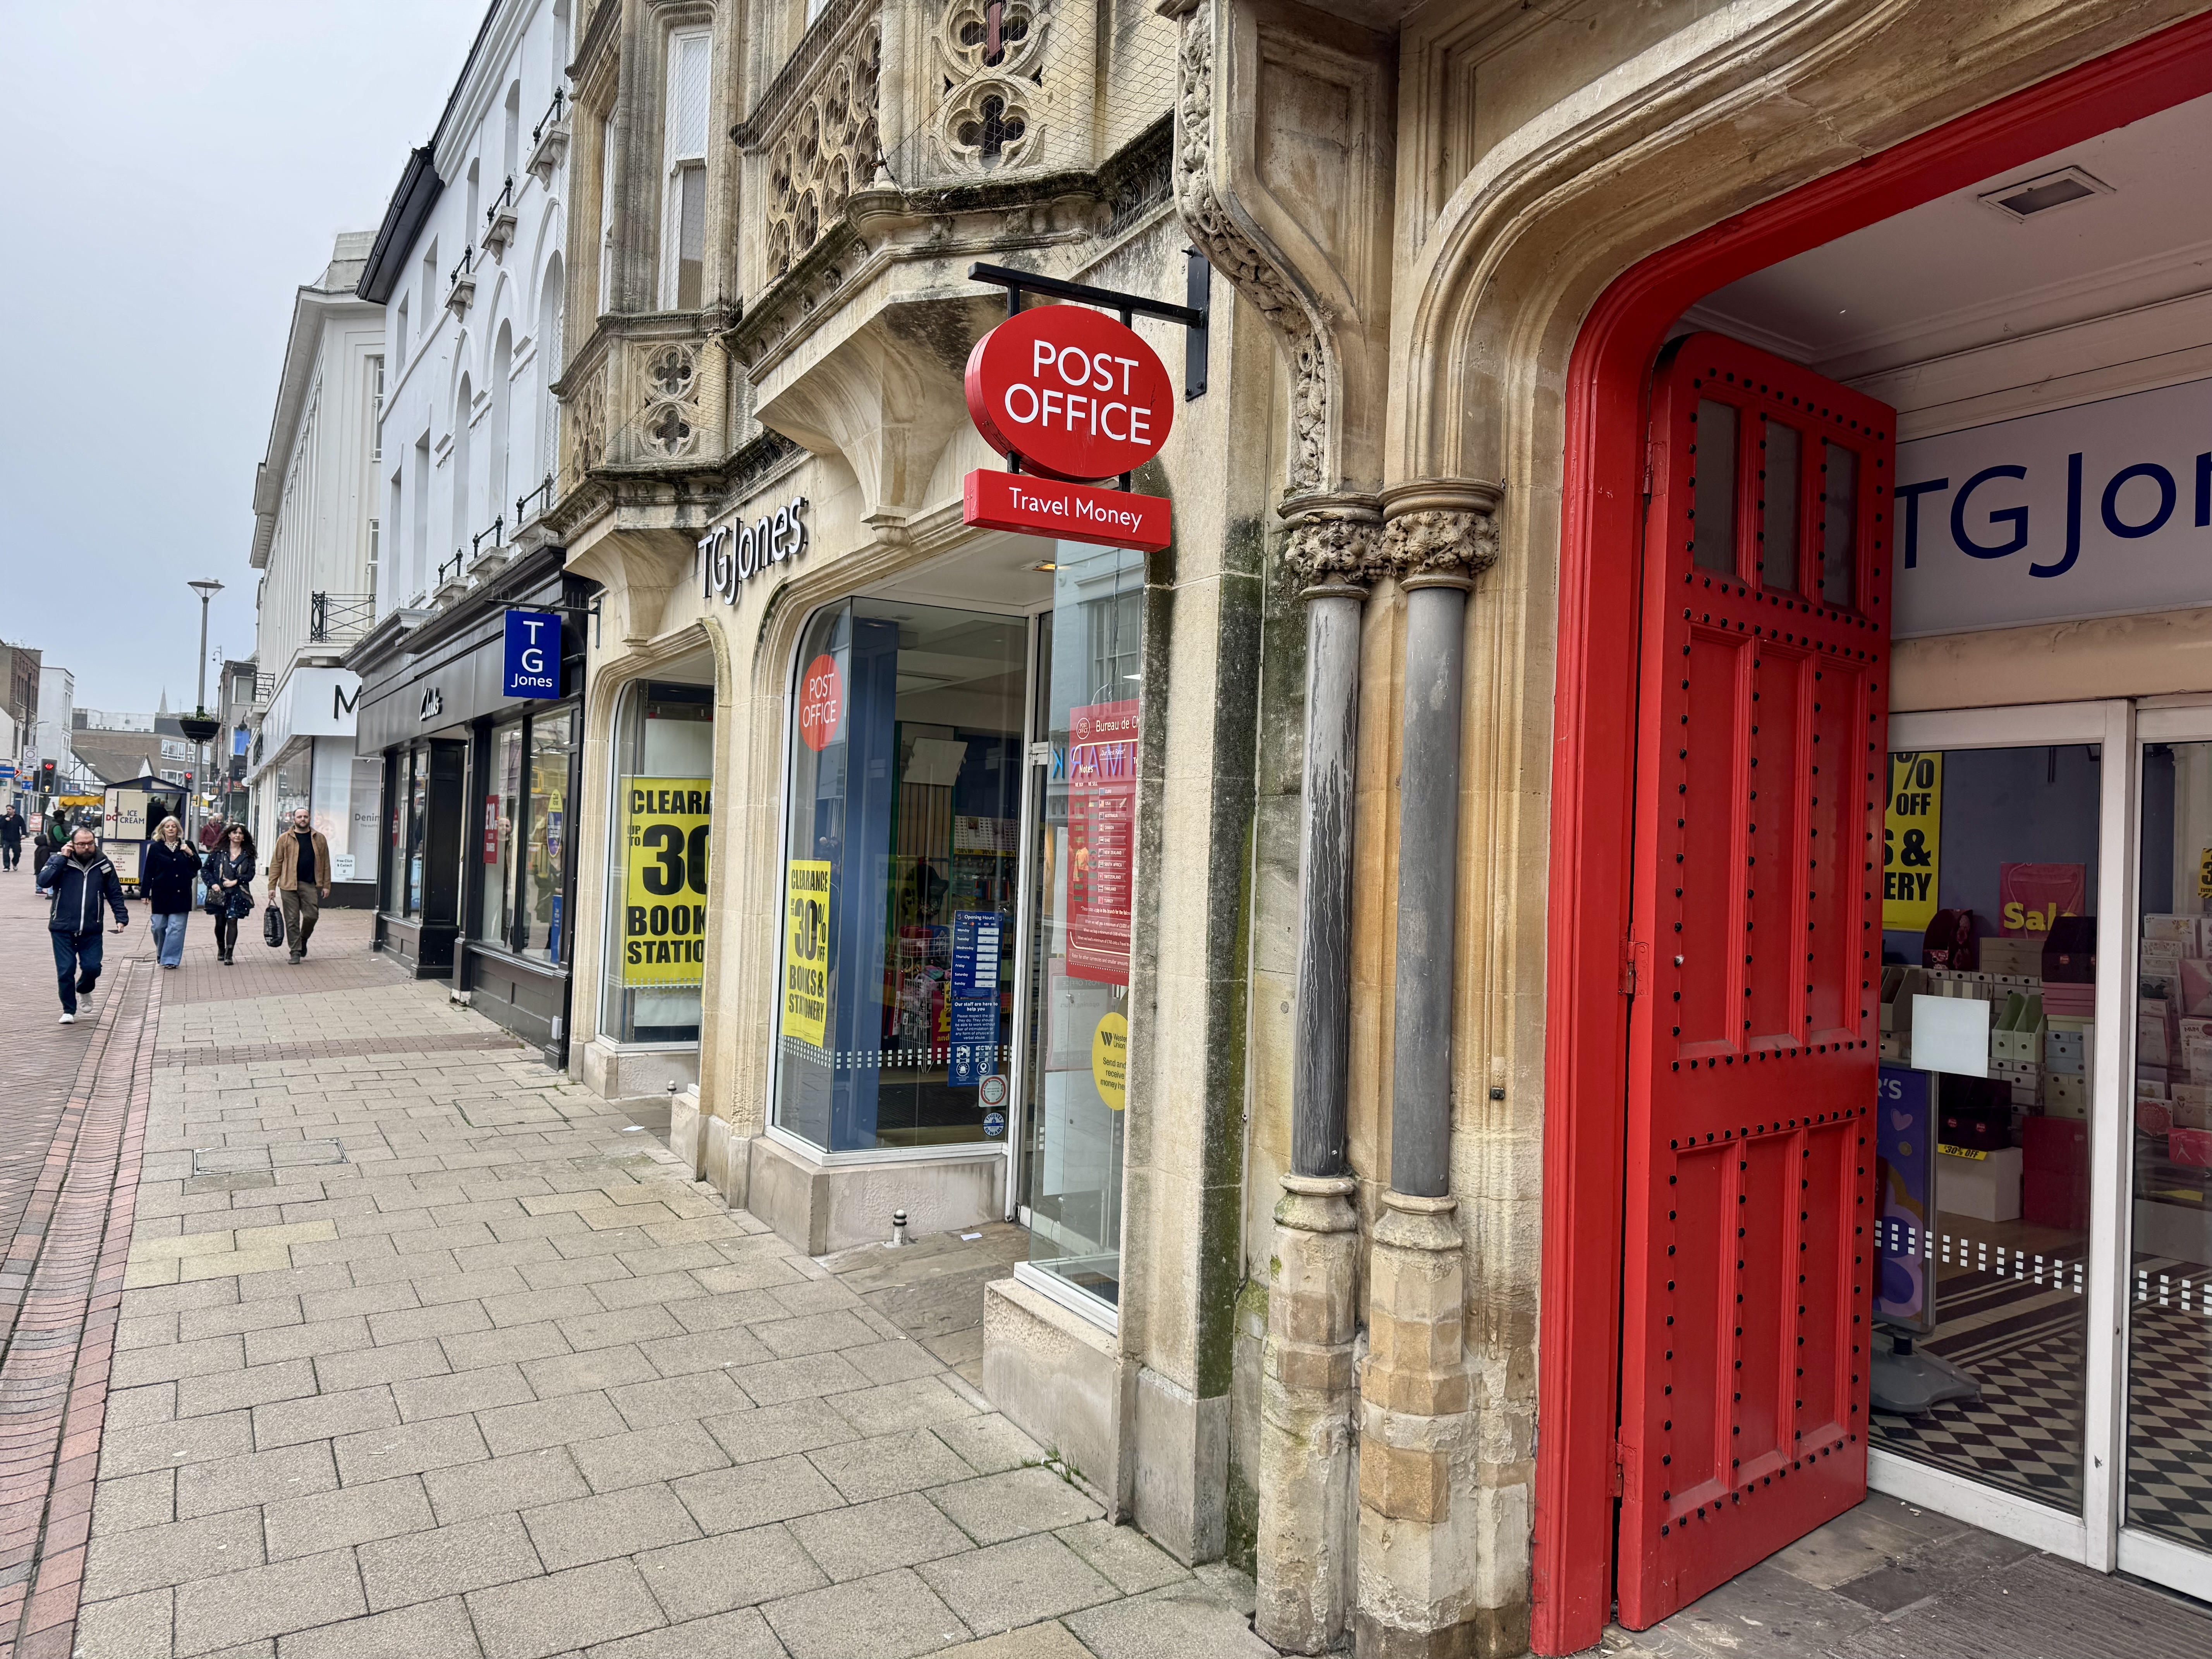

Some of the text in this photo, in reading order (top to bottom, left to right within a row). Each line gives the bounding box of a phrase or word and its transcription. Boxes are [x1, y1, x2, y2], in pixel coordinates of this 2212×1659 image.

[1034, 340, 1139, 395] POST
[1005, 383, 1151, 445] OFFICE
[1009, 487, 1142, 533] Travel Money
[523, 621, 544, 644] T
[522, 648, 543, 673] G
[511, 673, 552, 688] Jones
[810, 673, 834, 700] POST
[419, 687, 439, 721] Clarks
[803, 700, 836, 728] OFFICE
[1096, 717, 1130, 732] Bureau de
[1079, 764, 1093, 774] Notes
[1896, 793, 1931, 816] OFF
[627, 825, 641, 835] UP
[627, 836, 641, 846] TO
[1901, 829, 1931, 866] &
[792, 869, 828, 892] CLEARANCE
[2004, 902, 2077, 931] Sal
[817, 945, 825, 962] OFF
[817, 971, 824, 998] &
[1113, 1041, 1125, 1049] Union
[1103, 1057, 1116, 1066] Send
[1101, 1079, 1117, 1090] money
[1106, 1070, 1125, 1079] receive
[1946, 1146, 1979, 1158] 30% OFF
